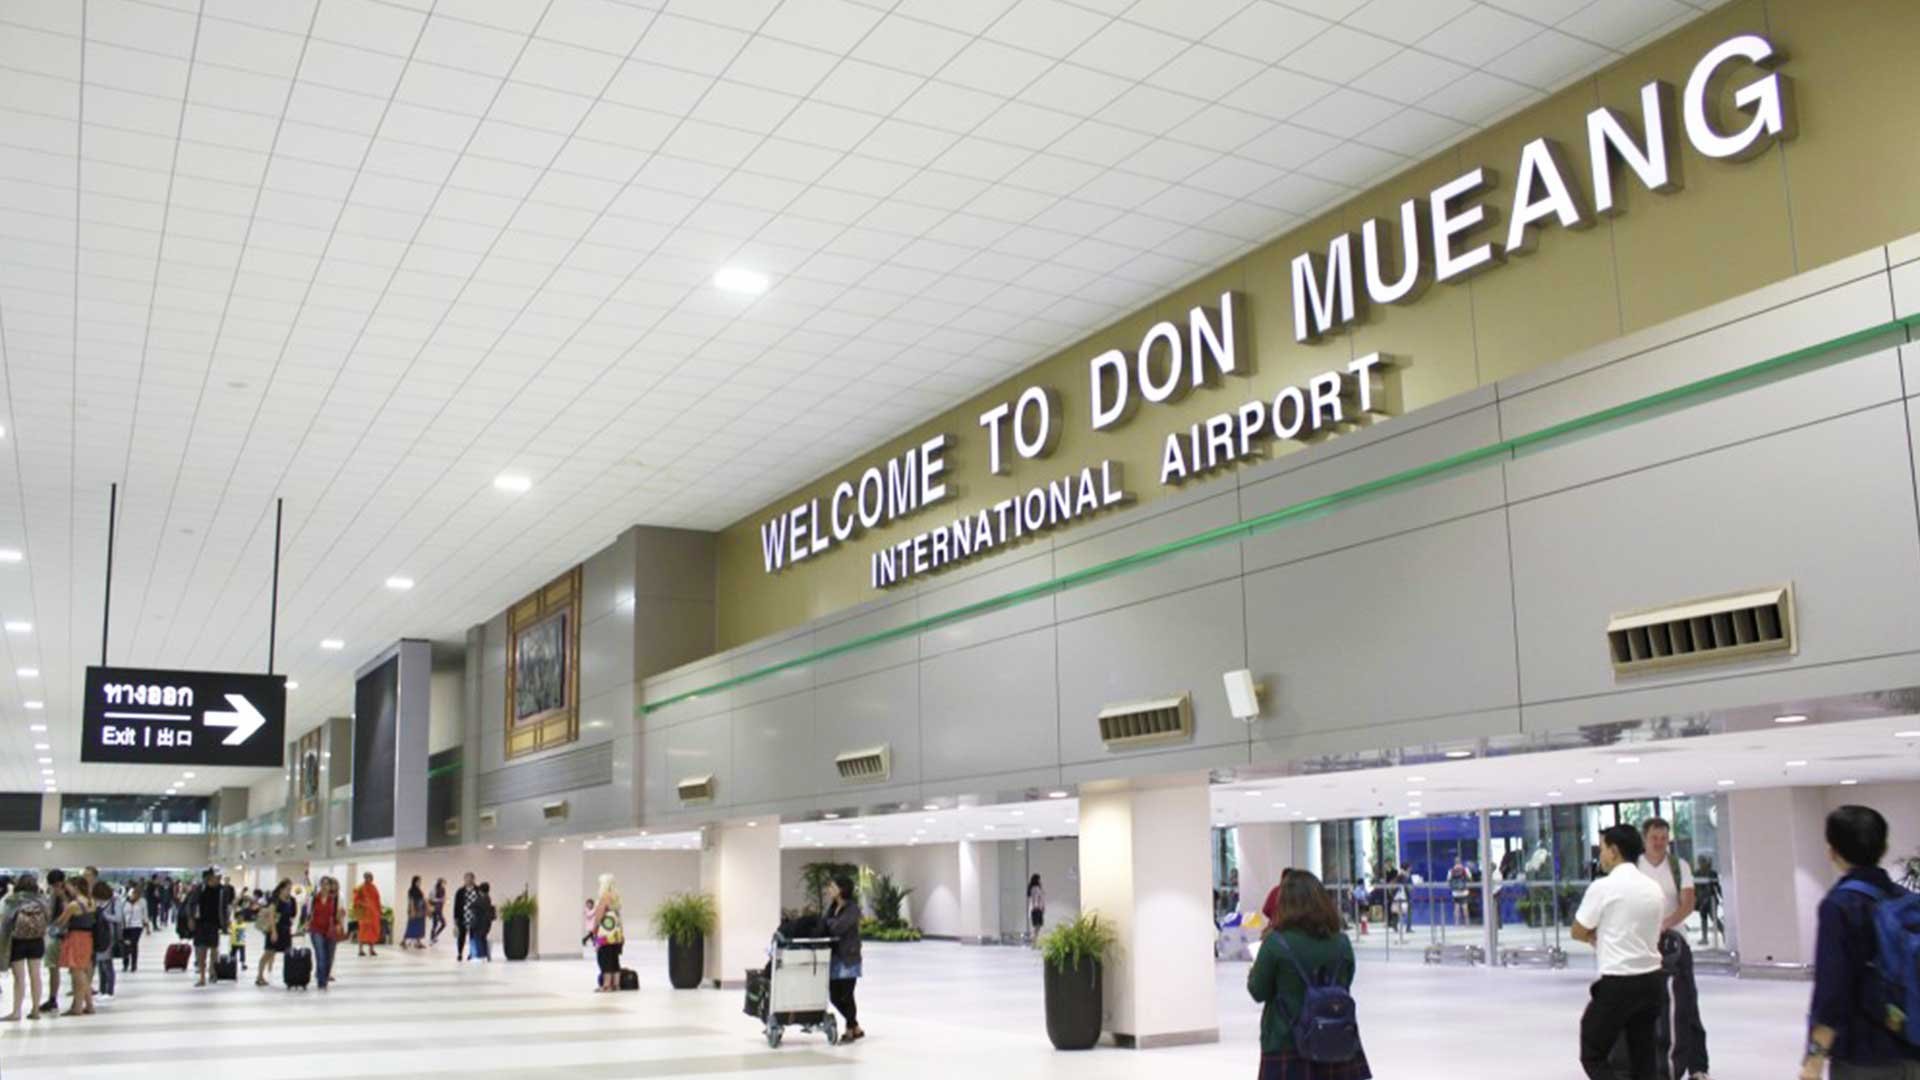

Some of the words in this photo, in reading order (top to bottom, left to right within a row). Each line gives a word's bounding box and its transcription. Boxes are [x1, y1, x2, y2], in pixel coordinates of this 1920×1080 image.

[760, 433, 947, 573] WELCOME
[979, 385, 1050, 475] TO
[1090, 290, 1236, 430] DON
[1290, 34, 1783, 342] MUEANG
[870, 459, 1123, 588] INTERNATIONAL
[1160, 351, 1380, 484] AIRPORT
[102, 725, 136, 746] Exit
[157, 727, 192, 747] 出口
[103, 682, 194, 707] ทางออก
